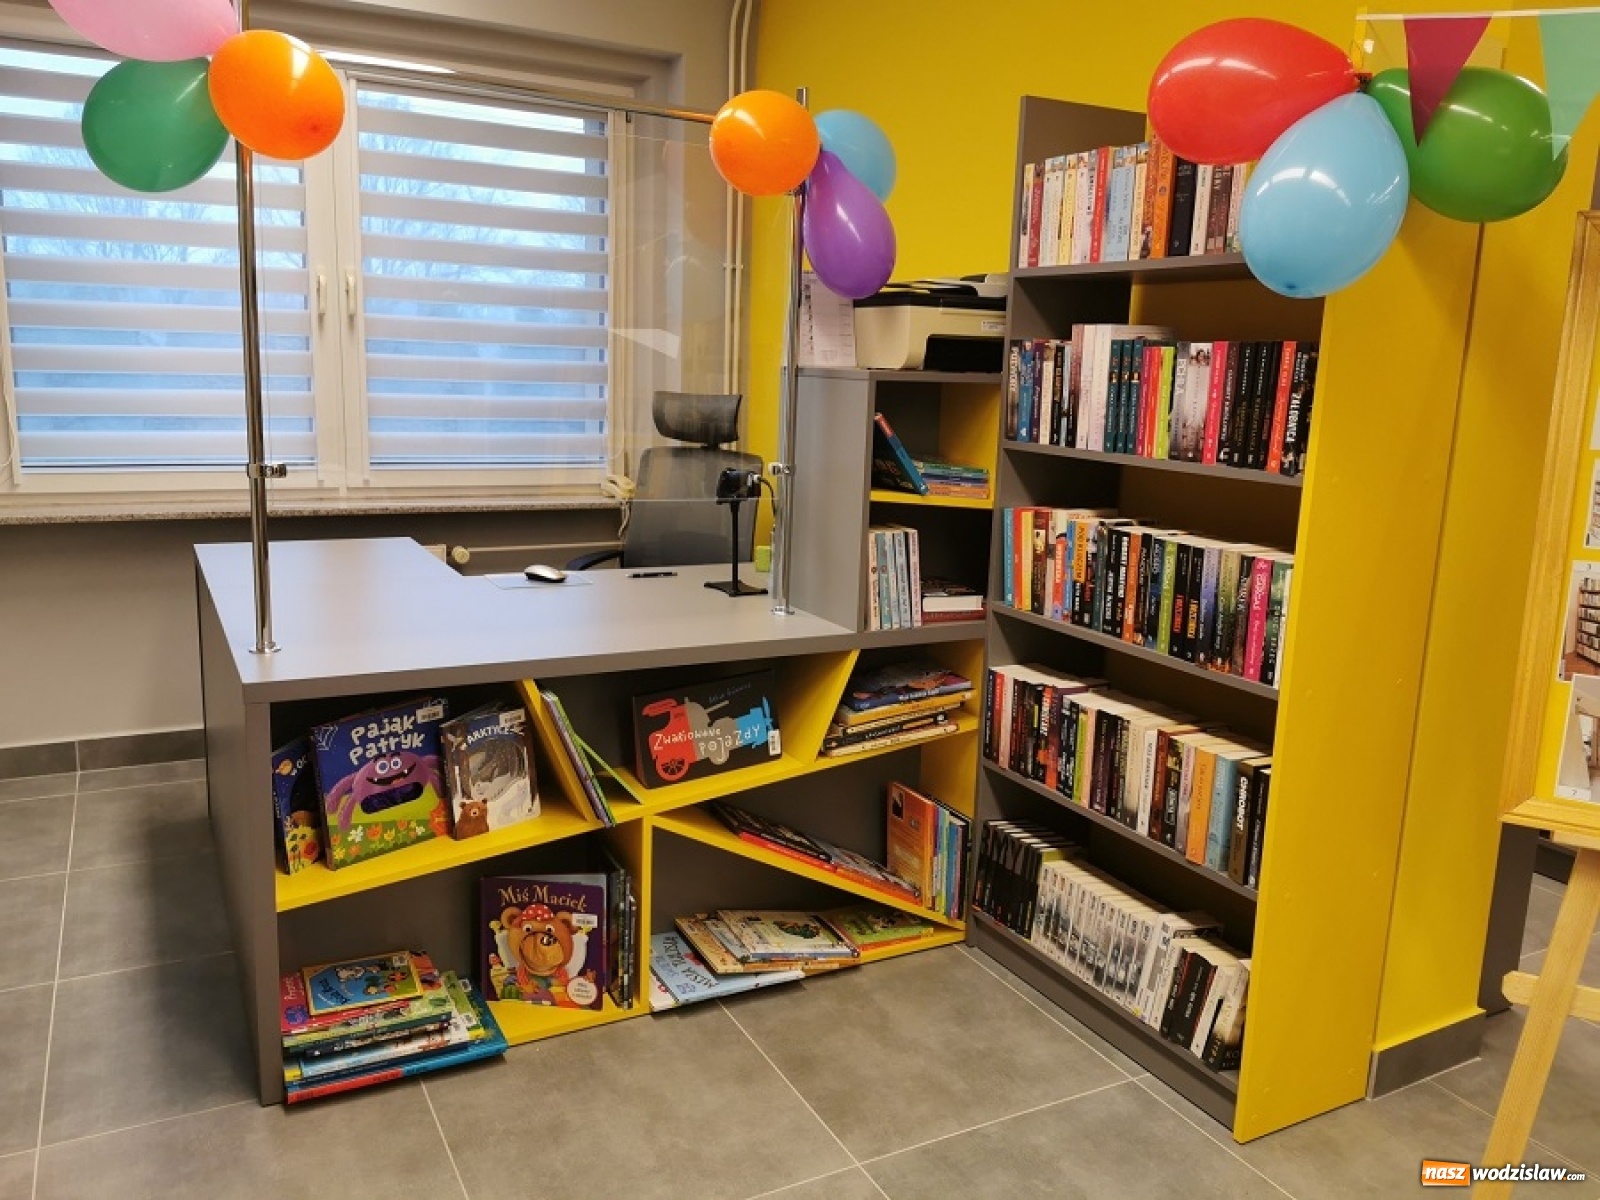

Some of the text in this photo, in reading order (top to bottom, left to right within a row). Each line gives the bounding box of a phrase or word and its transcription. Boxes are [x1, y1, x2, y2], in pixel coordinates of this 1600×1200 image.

[349, 732, 425, 766] Patryk
[498, 885, 587, 912] Miś Maciek
